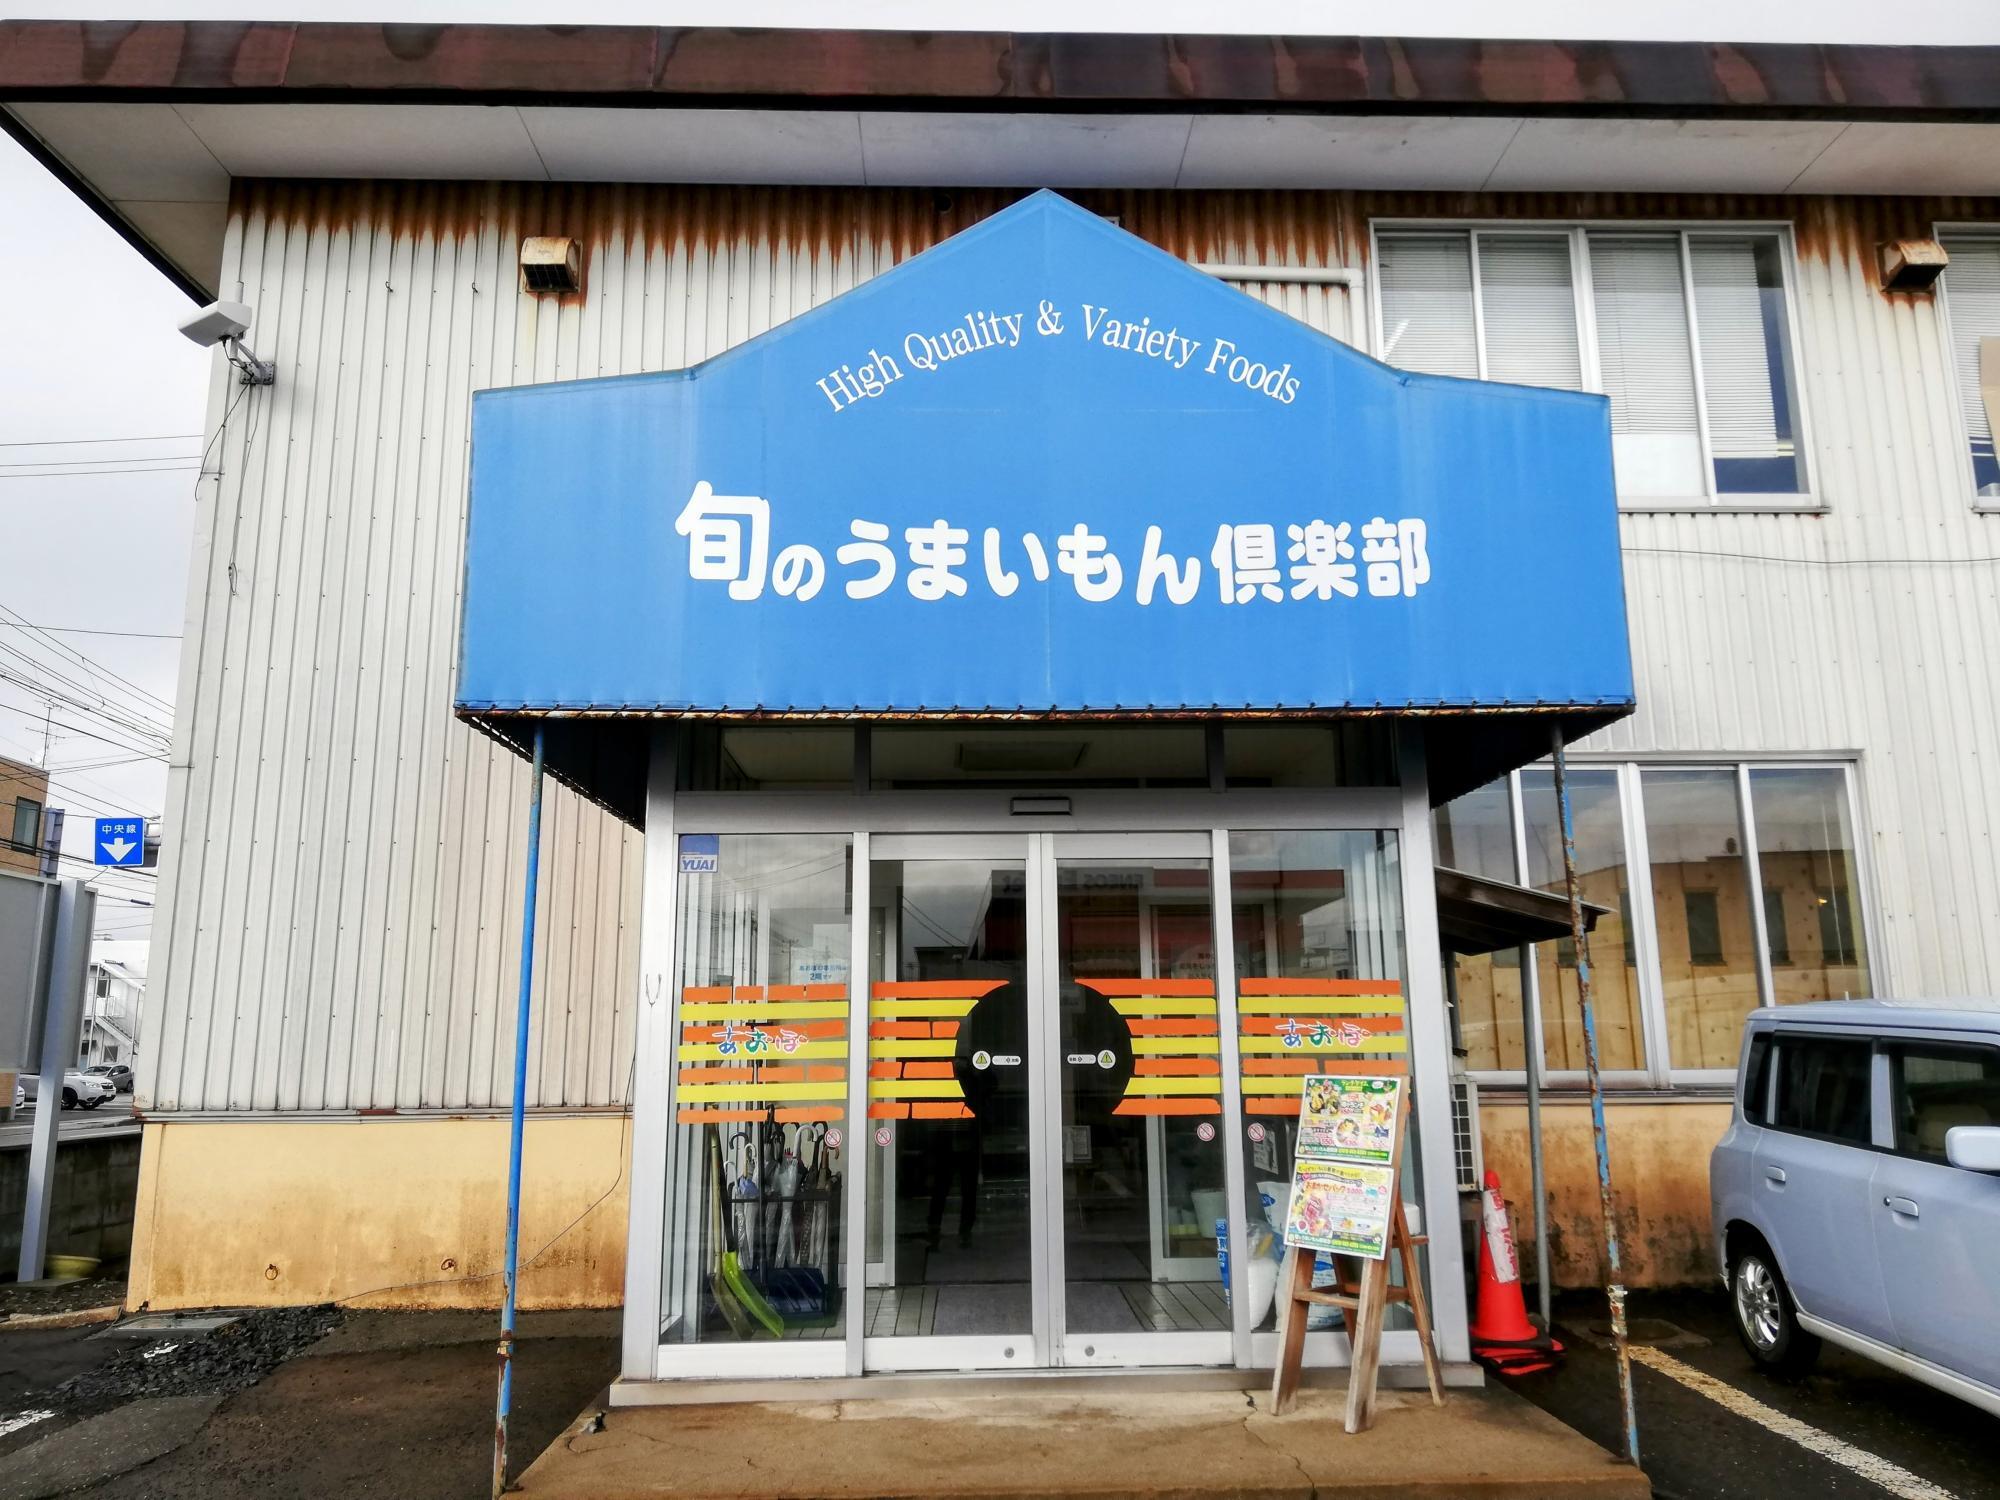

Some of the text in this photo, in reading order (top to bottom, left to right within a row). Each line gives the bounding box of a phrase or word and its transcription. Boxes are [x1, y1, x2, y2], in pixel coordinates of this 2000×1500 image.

[816, 299, 1301, 412] High Quality & Variety Foods
[675, 481, 1430, 605] 旬のうまいもん倶楽部
[102, 824, 136, 834] 中央線
[682, 859, 715, 870] YUAI
